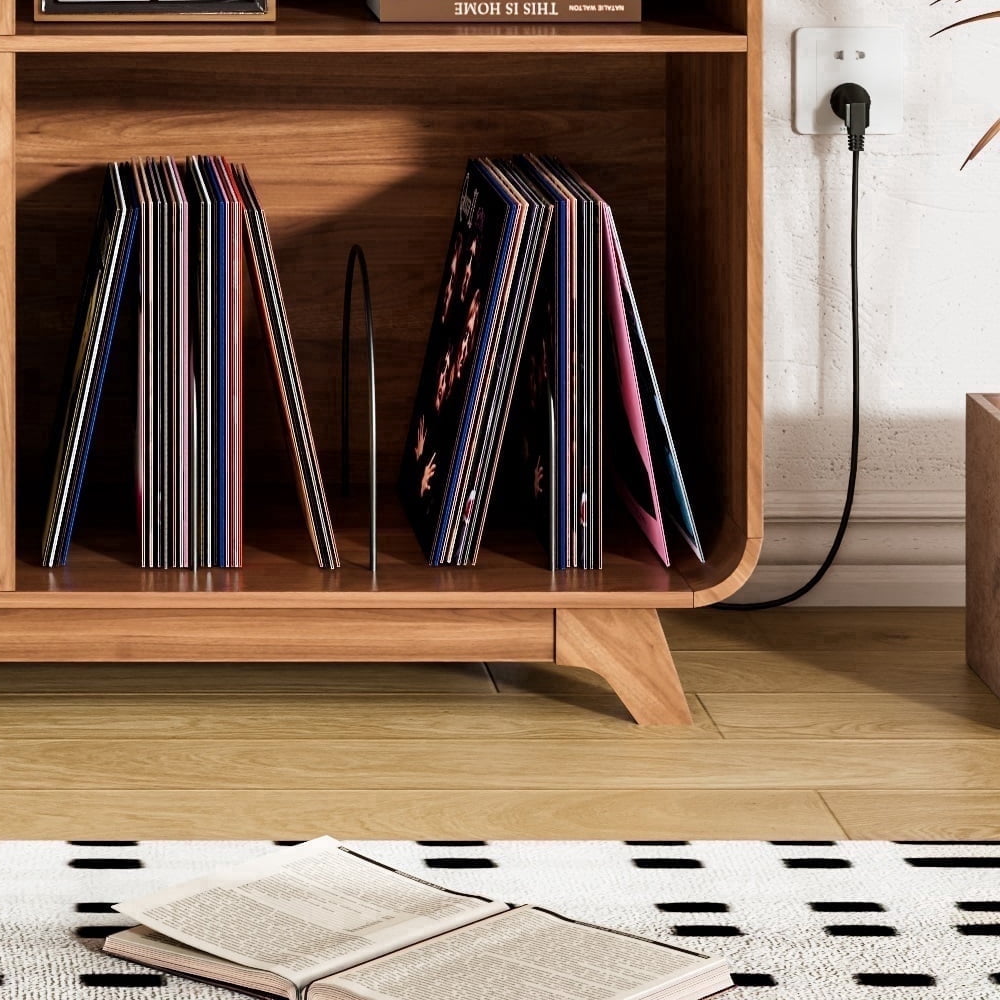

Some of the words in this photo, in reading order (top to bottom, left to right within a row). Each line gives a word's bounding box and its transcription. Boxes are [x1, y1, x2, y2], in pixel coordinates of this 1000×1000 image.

[454, 2, 501, 16] HOME
[505, 2, 519, 15] IS
[523, 2, 559, 15] THIS
